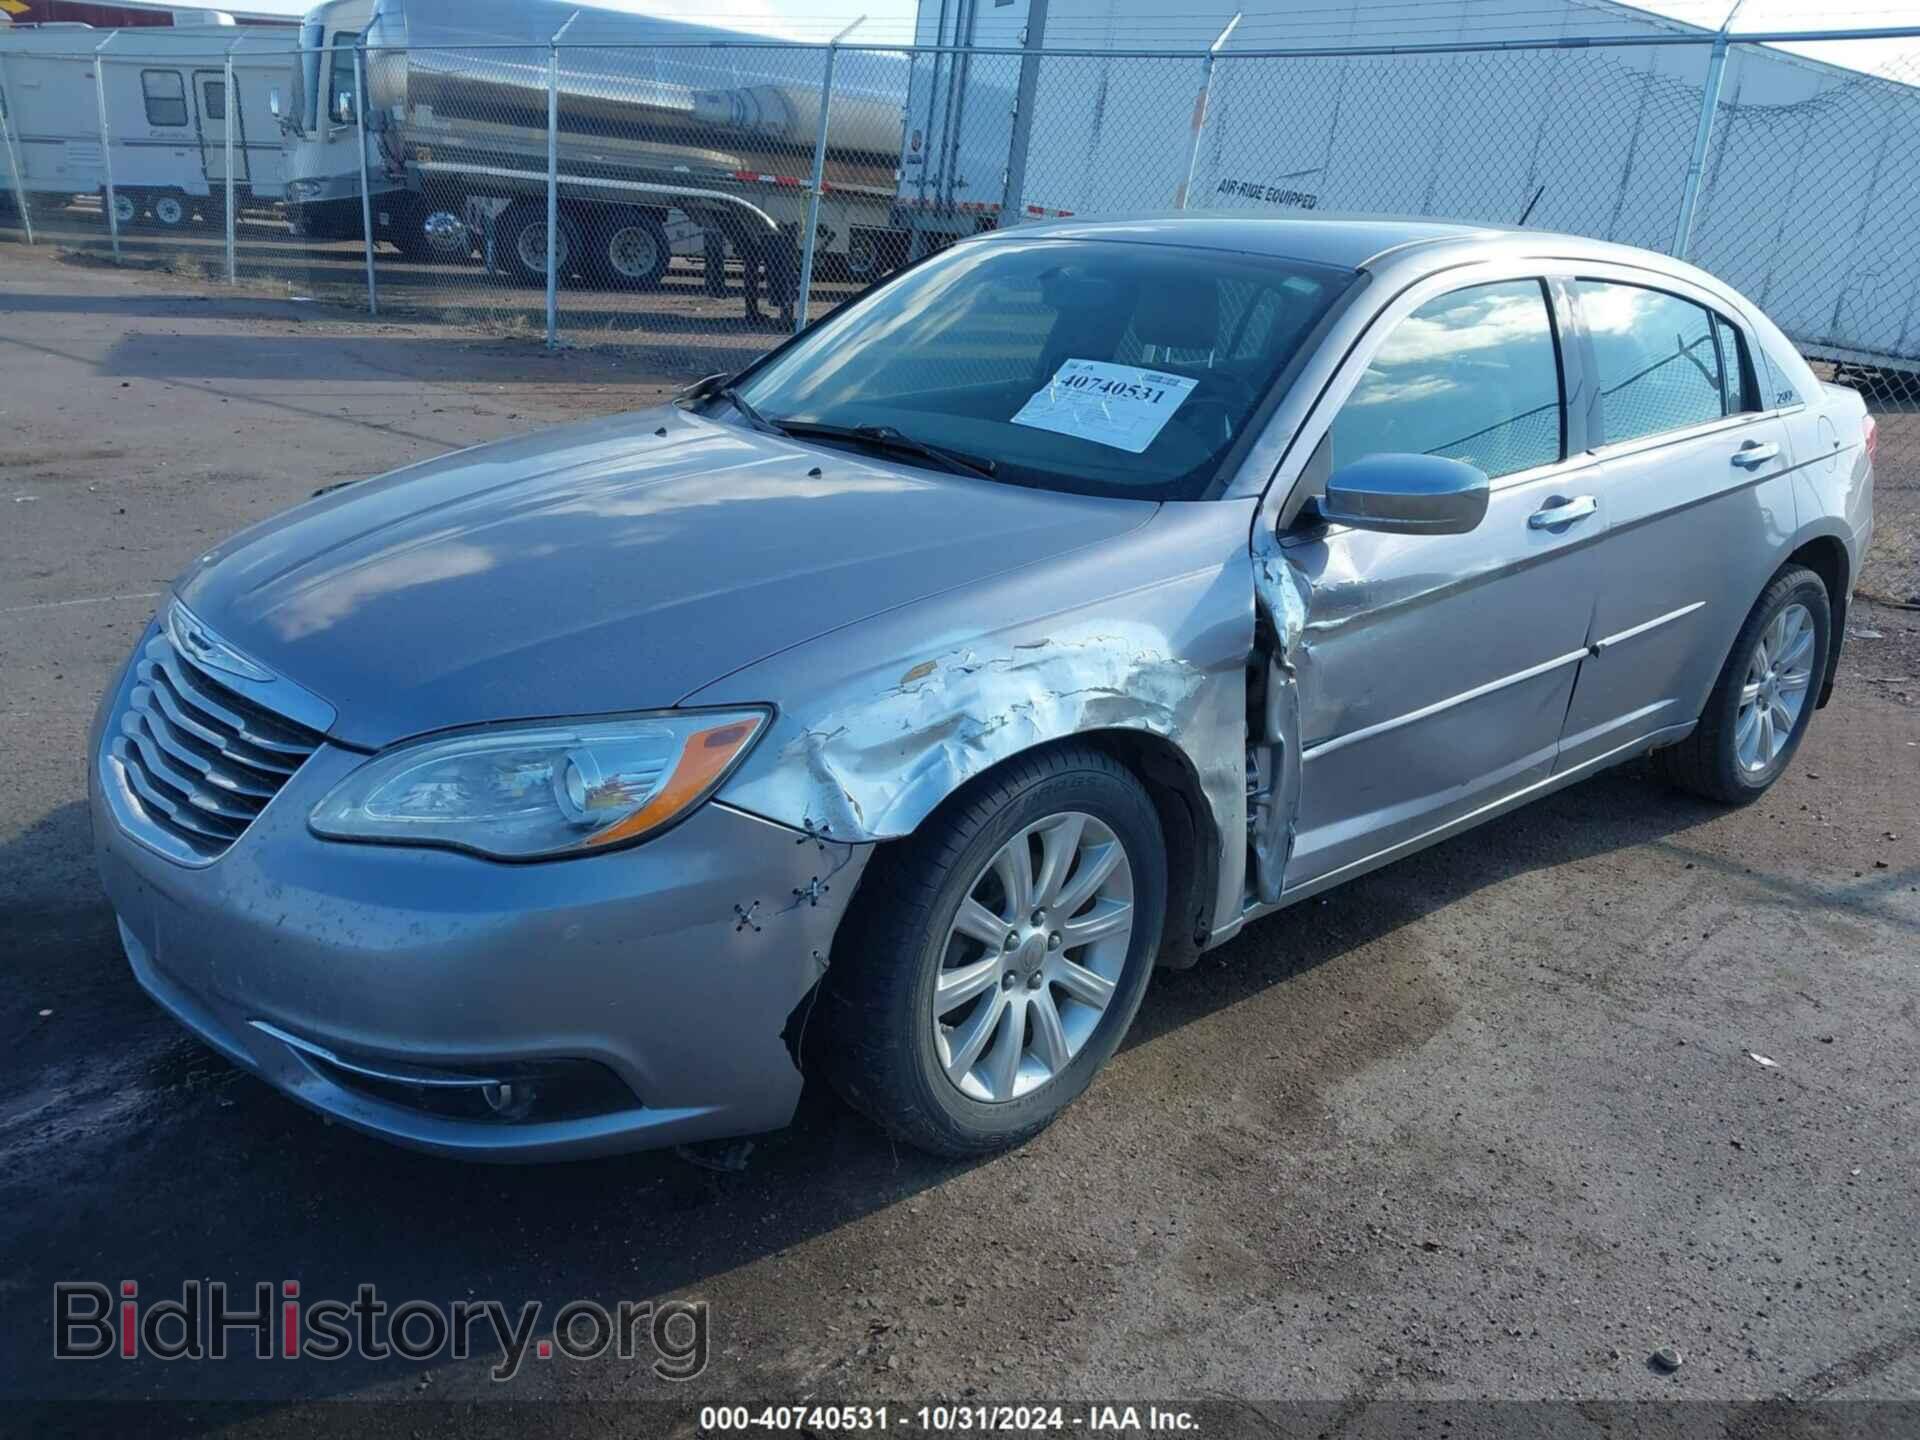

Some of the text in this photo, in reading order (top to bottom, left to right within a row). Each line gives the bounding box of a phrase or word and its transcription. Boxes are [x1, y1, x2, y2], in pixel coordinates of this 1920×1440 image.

[1217, 178, 1317, 210] AIR-RIDE EQUIPPED
[1060, 373, 1165, 404] 40740531
